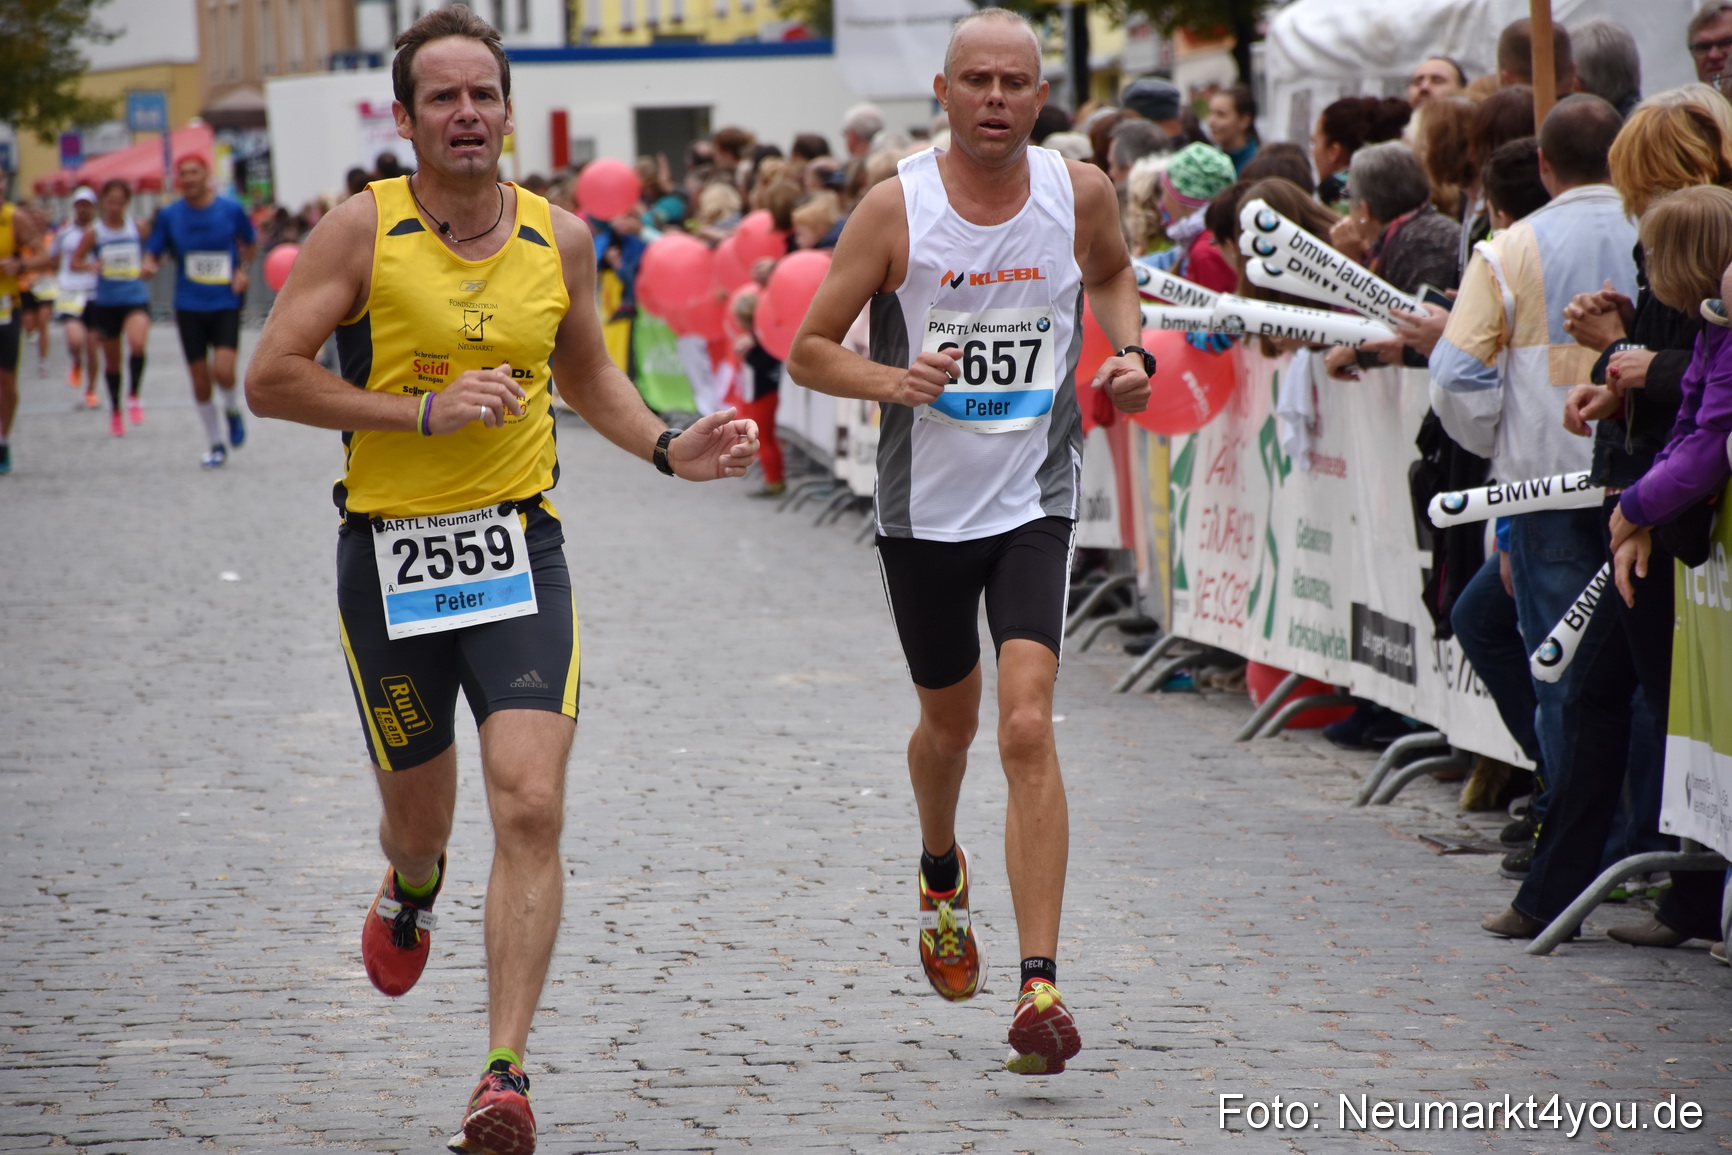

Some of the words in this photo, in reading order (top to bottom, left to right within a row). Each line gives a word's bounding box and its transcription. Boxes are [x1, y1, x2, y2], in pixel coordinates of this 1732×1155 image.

[969, 267, 1046, 287] KLEBL
[1160, 279, 1211, 308] BMW
[449, 299, 499, 310] FONDSZENTRUM
[928, 321, 970, 336] PARTL
[971, 321, 1032, 334] Neumarkt
[414, 350, 449, 360] Schreinerei
[457, 342, 494, 352] NEUMARKT
[413, 359, 449, 376] Seidl
[417, 373, 444, 384] Berngau
[966, 399, 1011, 417] Peter
[1486, 477, 1552, 506] BMW
[382, 518, 424, 533] ARTL
[428, 508, 493, 528] Neumarkt
[392, 524, 515, 585] 2559
[387, 584, 395, 593] A
[1563, 562, 1612, 633] BMW
[434, 591, 485, 612] Peter
[509, 680, 549, 689] adidas
[388, 682, 426, 729] Run!
[379, 709, 404, 744] Team
[1024, 959, 1044, 969] TECH
